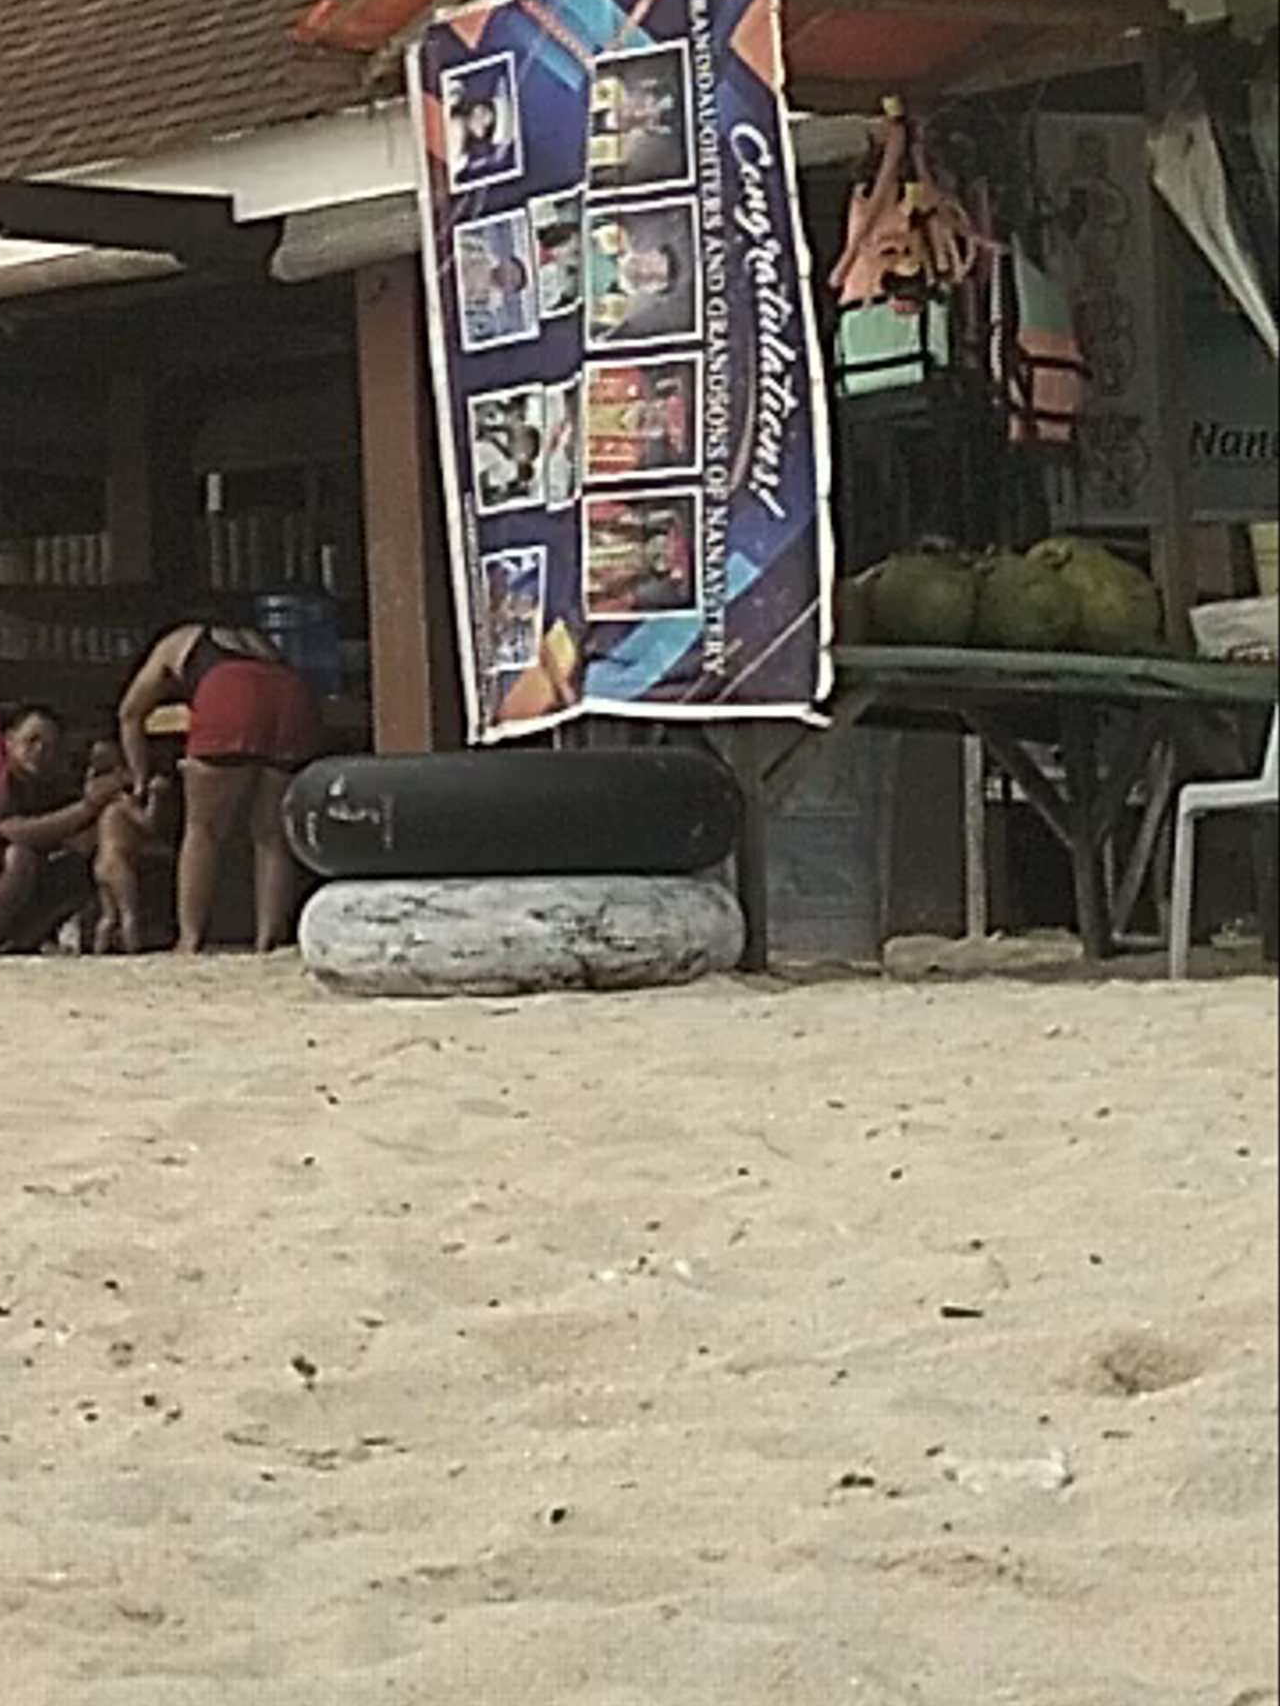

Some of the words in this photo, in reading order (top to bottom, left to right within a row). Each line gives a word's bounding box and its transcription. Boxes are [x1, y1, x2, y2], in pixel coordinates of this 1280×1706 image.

[701, 234, 728, 293] AND
[729, 122, 800, 519] Congratulations!
[705, 297, 730, 461] GRANDSONS
[705, 467, 730, 500] OF
